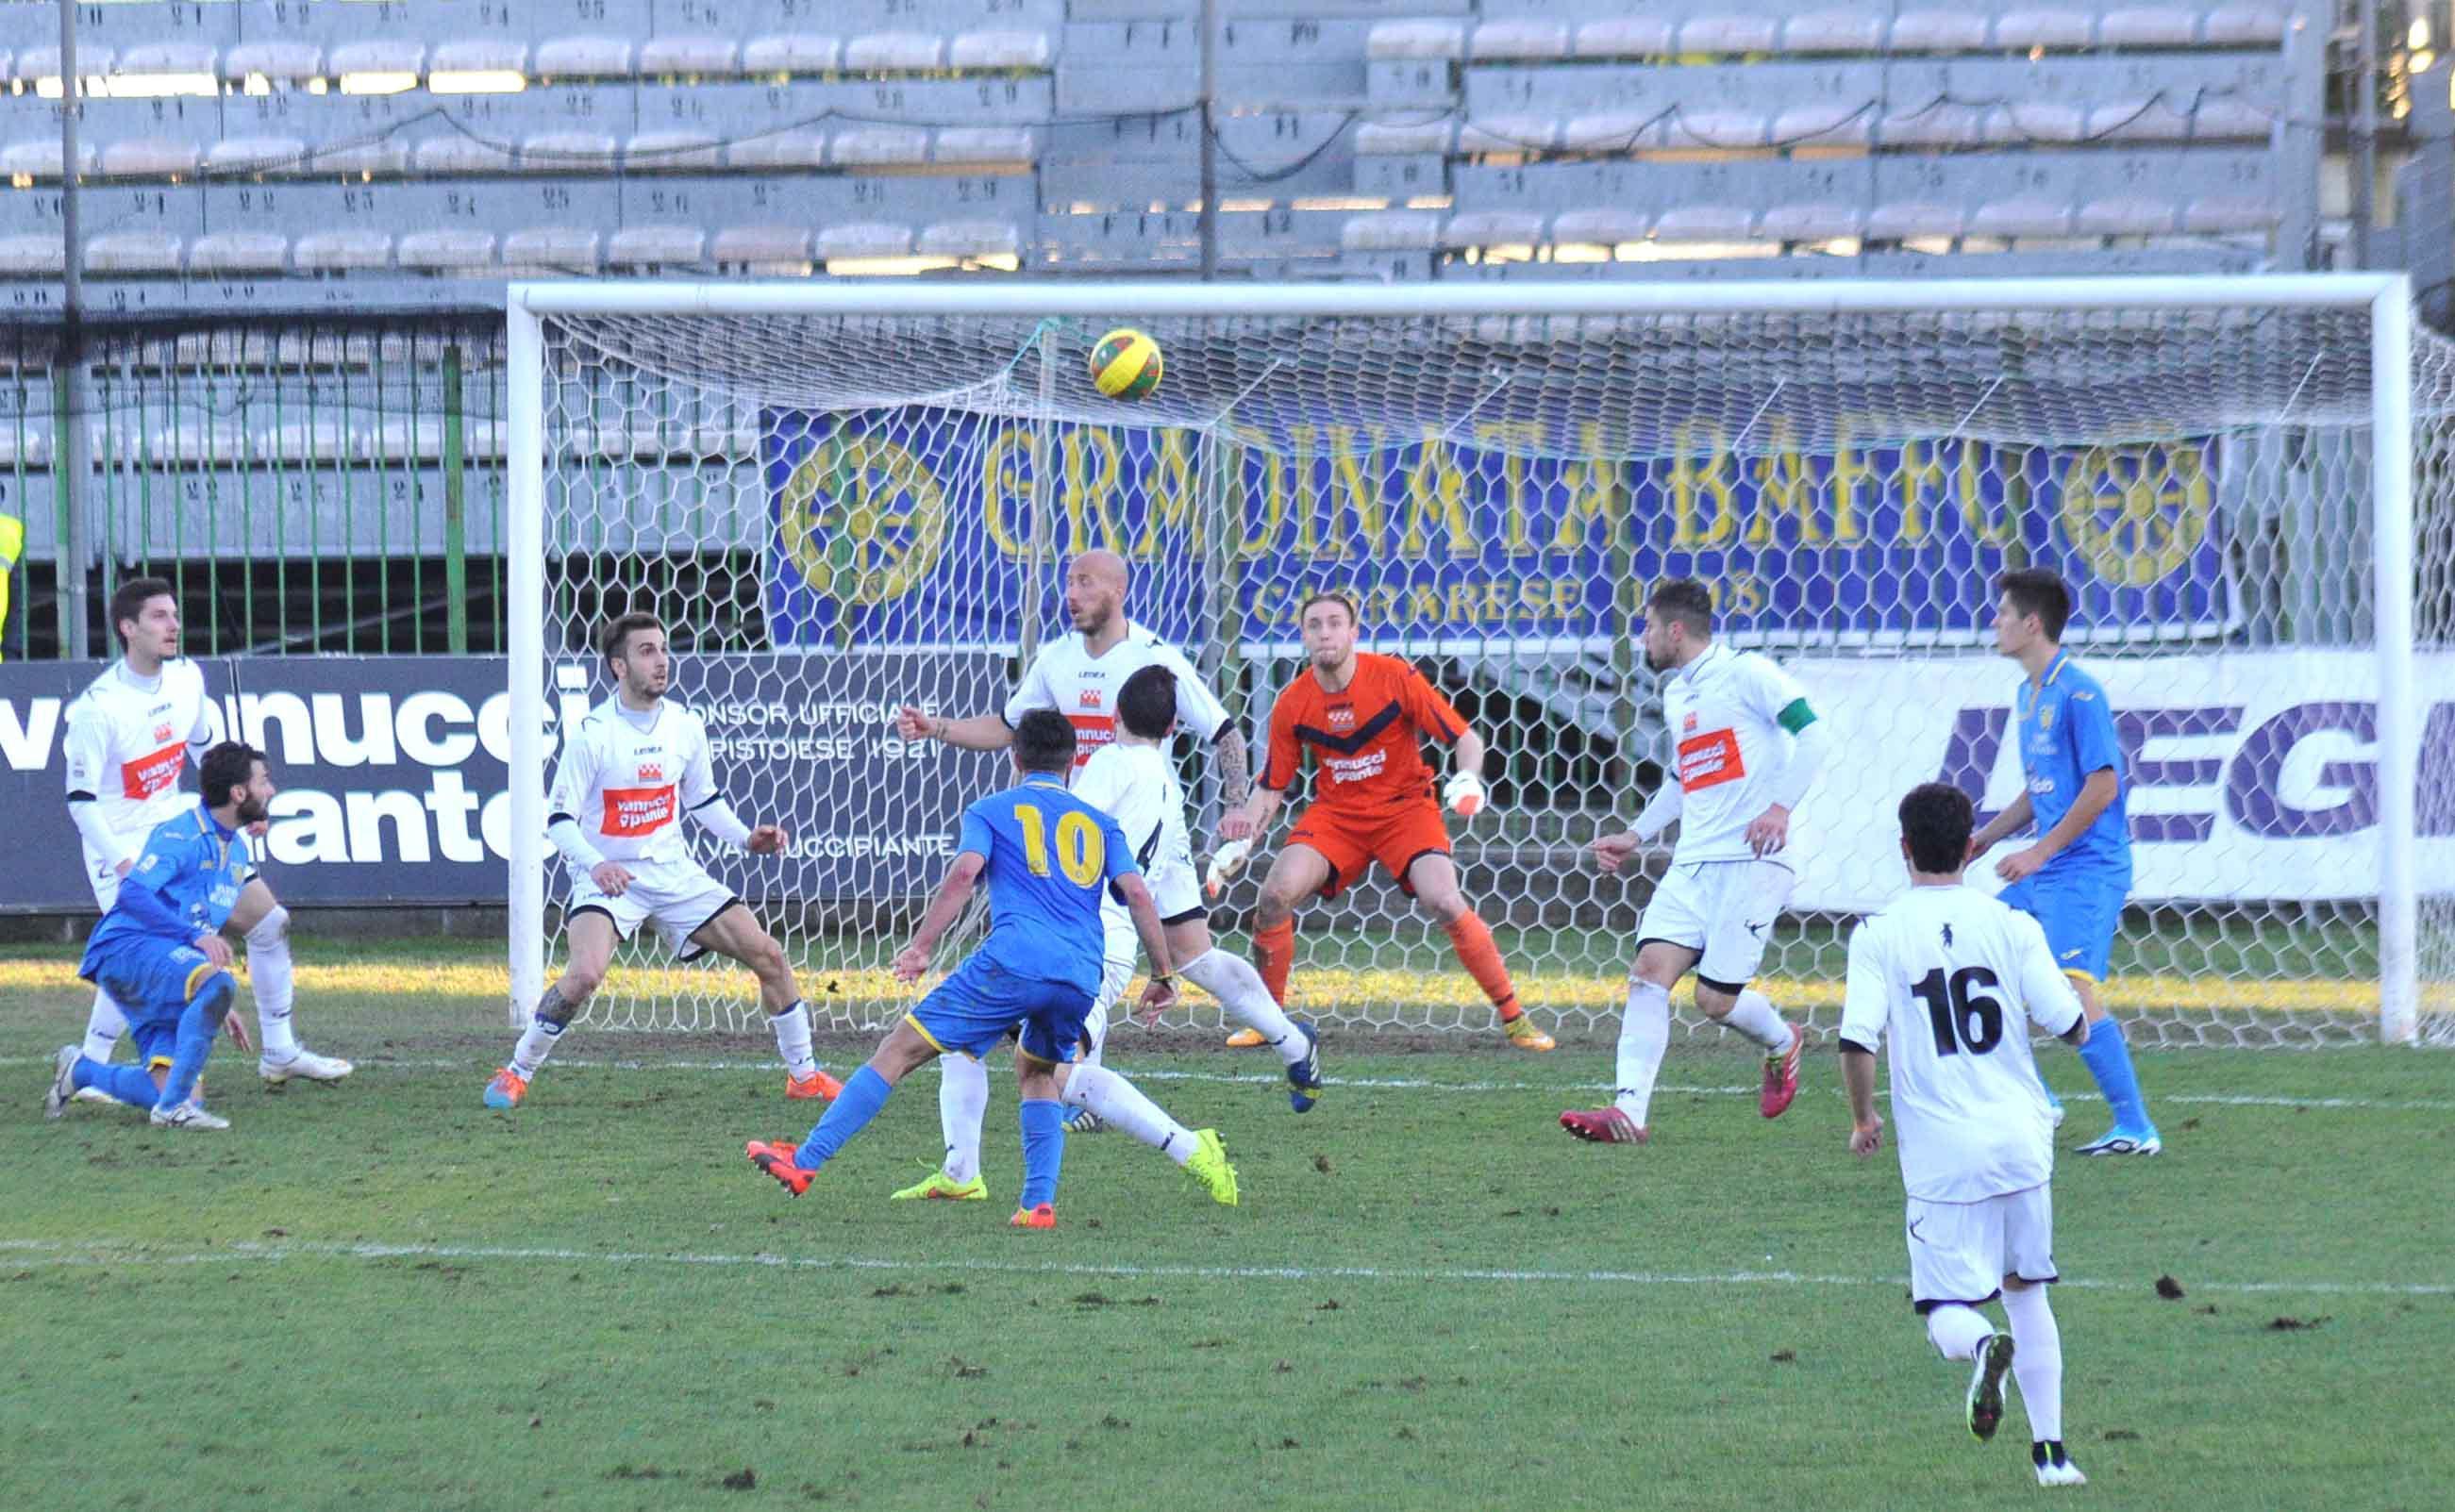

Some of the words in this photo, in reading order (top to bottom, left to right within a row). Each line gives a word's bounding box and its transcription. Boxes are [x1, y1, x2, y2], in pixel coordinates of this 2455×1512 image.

[709, 737, 856, 761] PISTOIESE
[871, 738, 939, 758] 1921
[1013, 804, 1106, 889] 10
[1909, 965, 2004, 1057] 16
